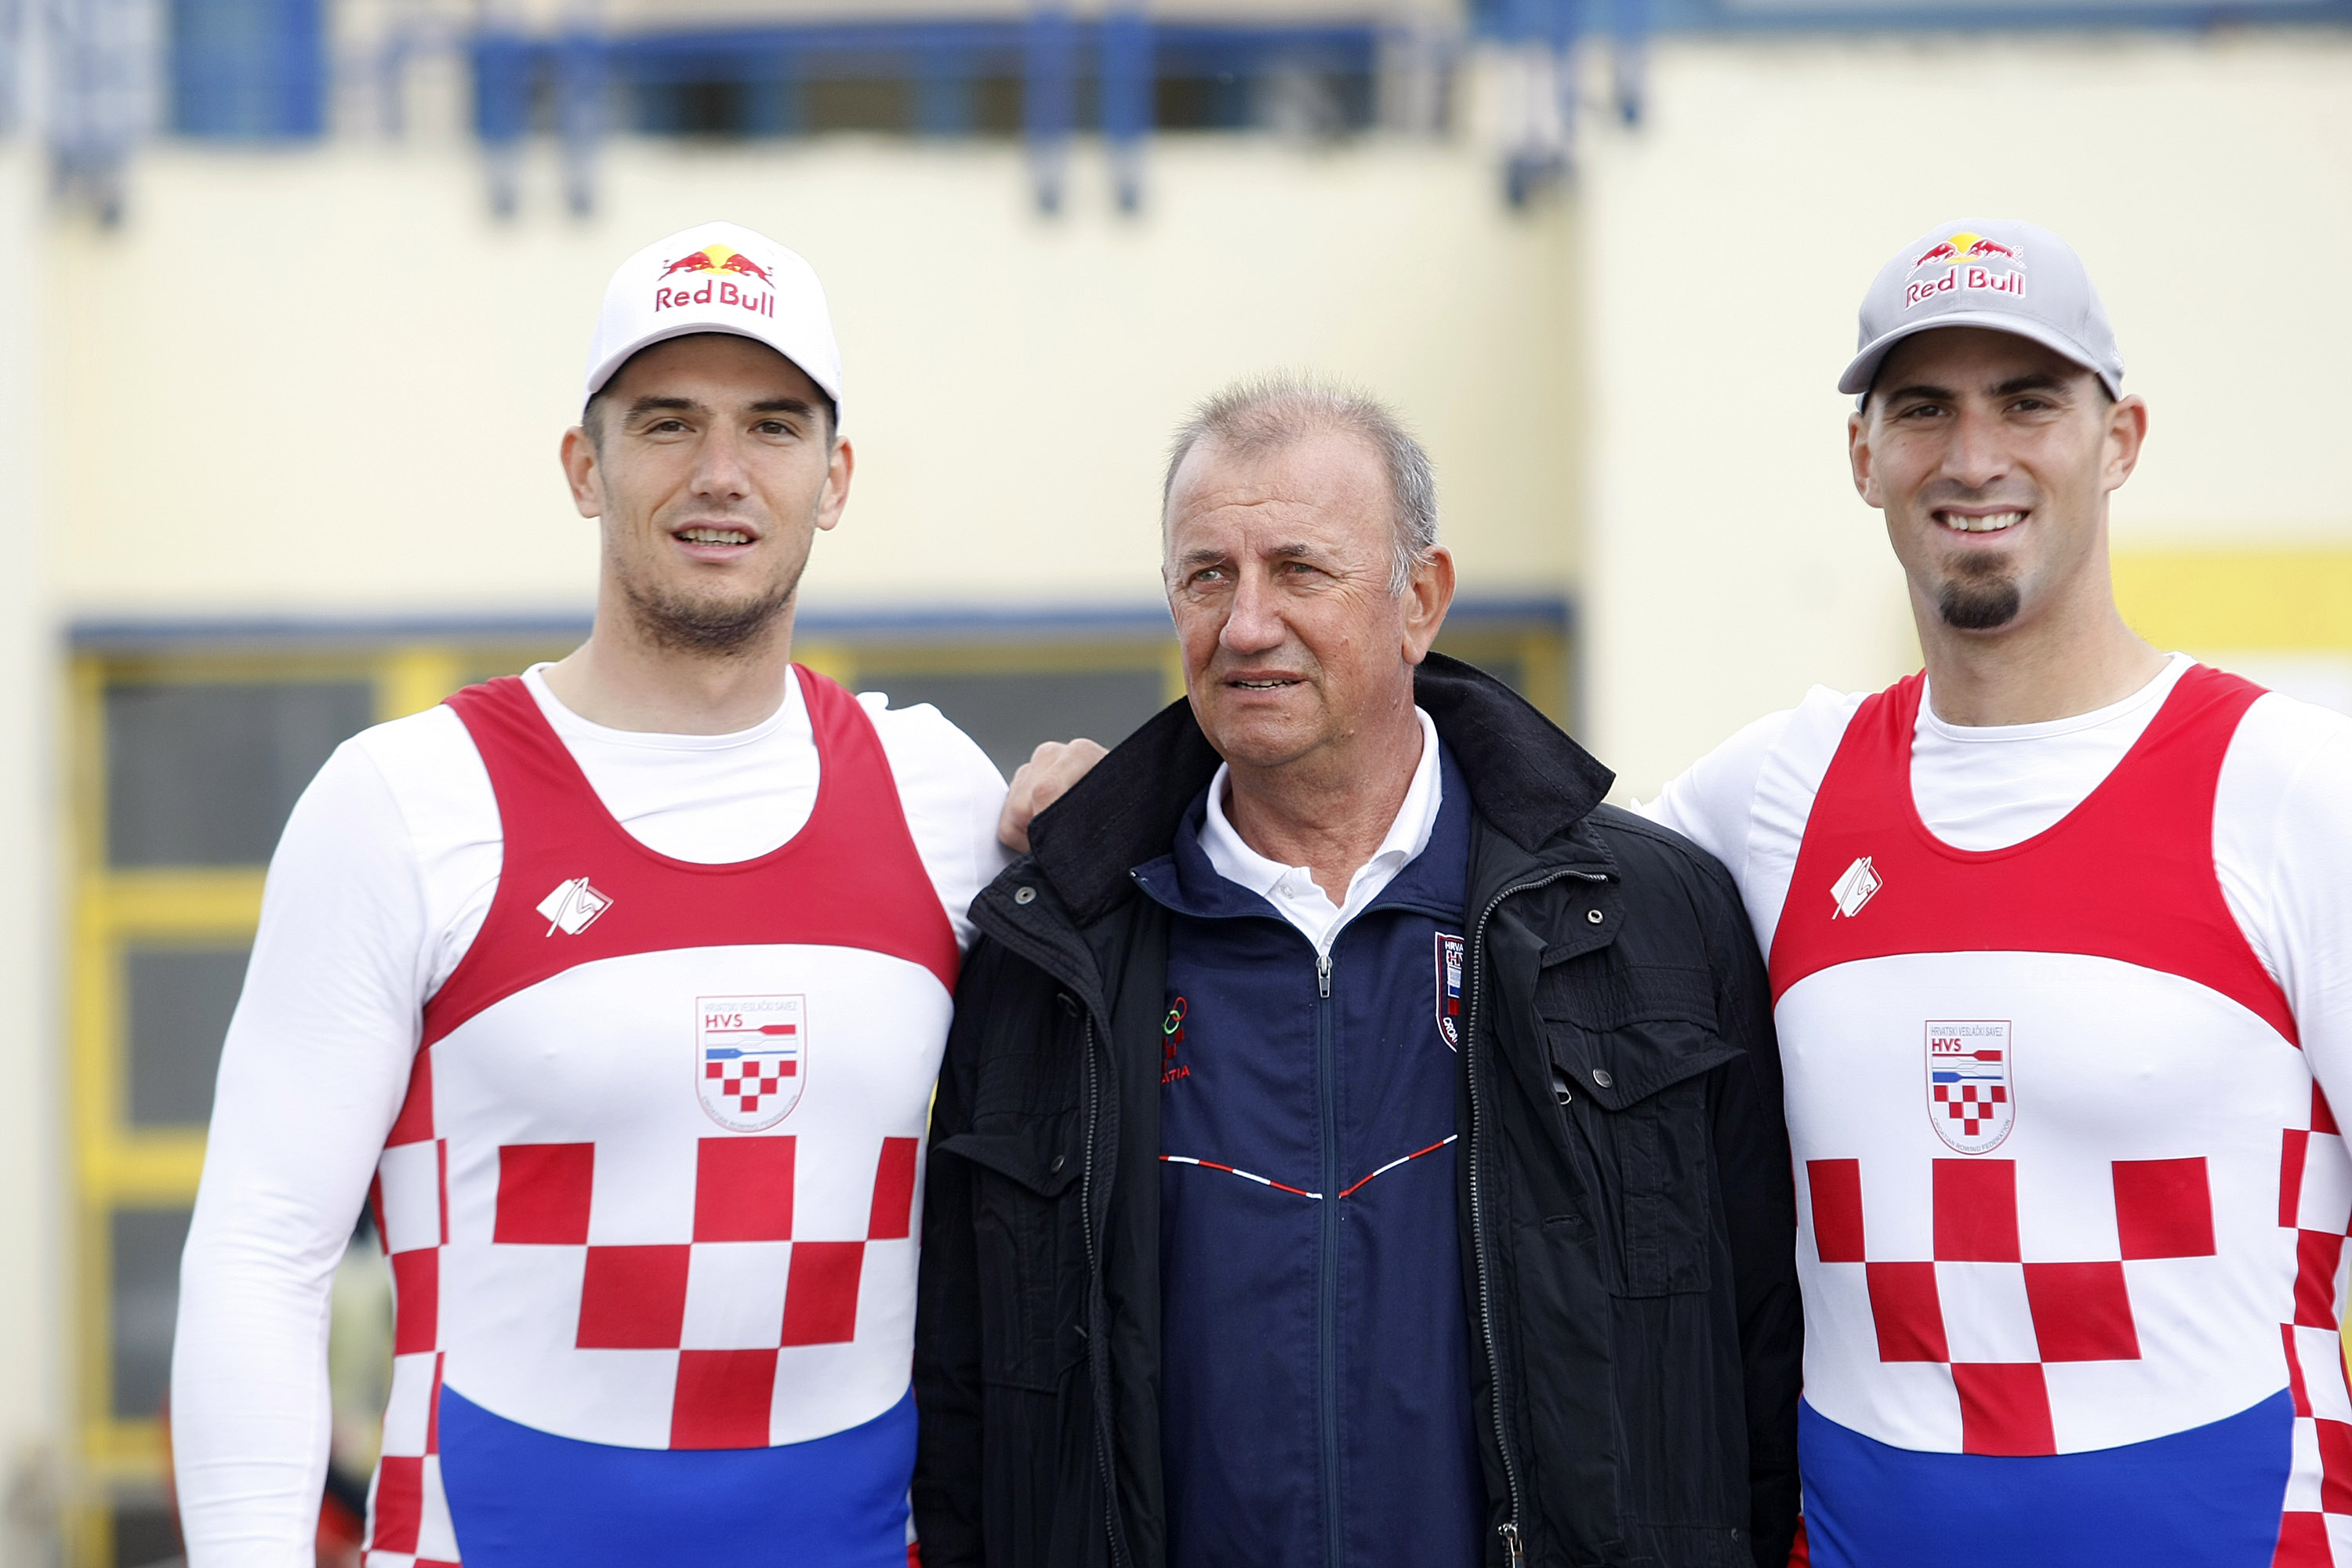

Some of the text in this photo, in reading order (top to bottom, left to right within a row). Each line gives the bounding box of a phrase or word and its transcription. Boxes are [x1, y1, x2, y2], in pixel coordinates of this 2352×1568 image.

[655, 279, 775, 319] Red Bull
[1905, 266, 2026, 310] Red Bull
[706, 1014, 744, 1028] HVS
[1931, 1026, 1958, 1036] HRVATSKI
[1986, 1026, 2004, 1036] SAVEZ
[1932, 1038, 1962, 1052] HVS
[1981, 1119, 2012, 1151] FEDERATION
